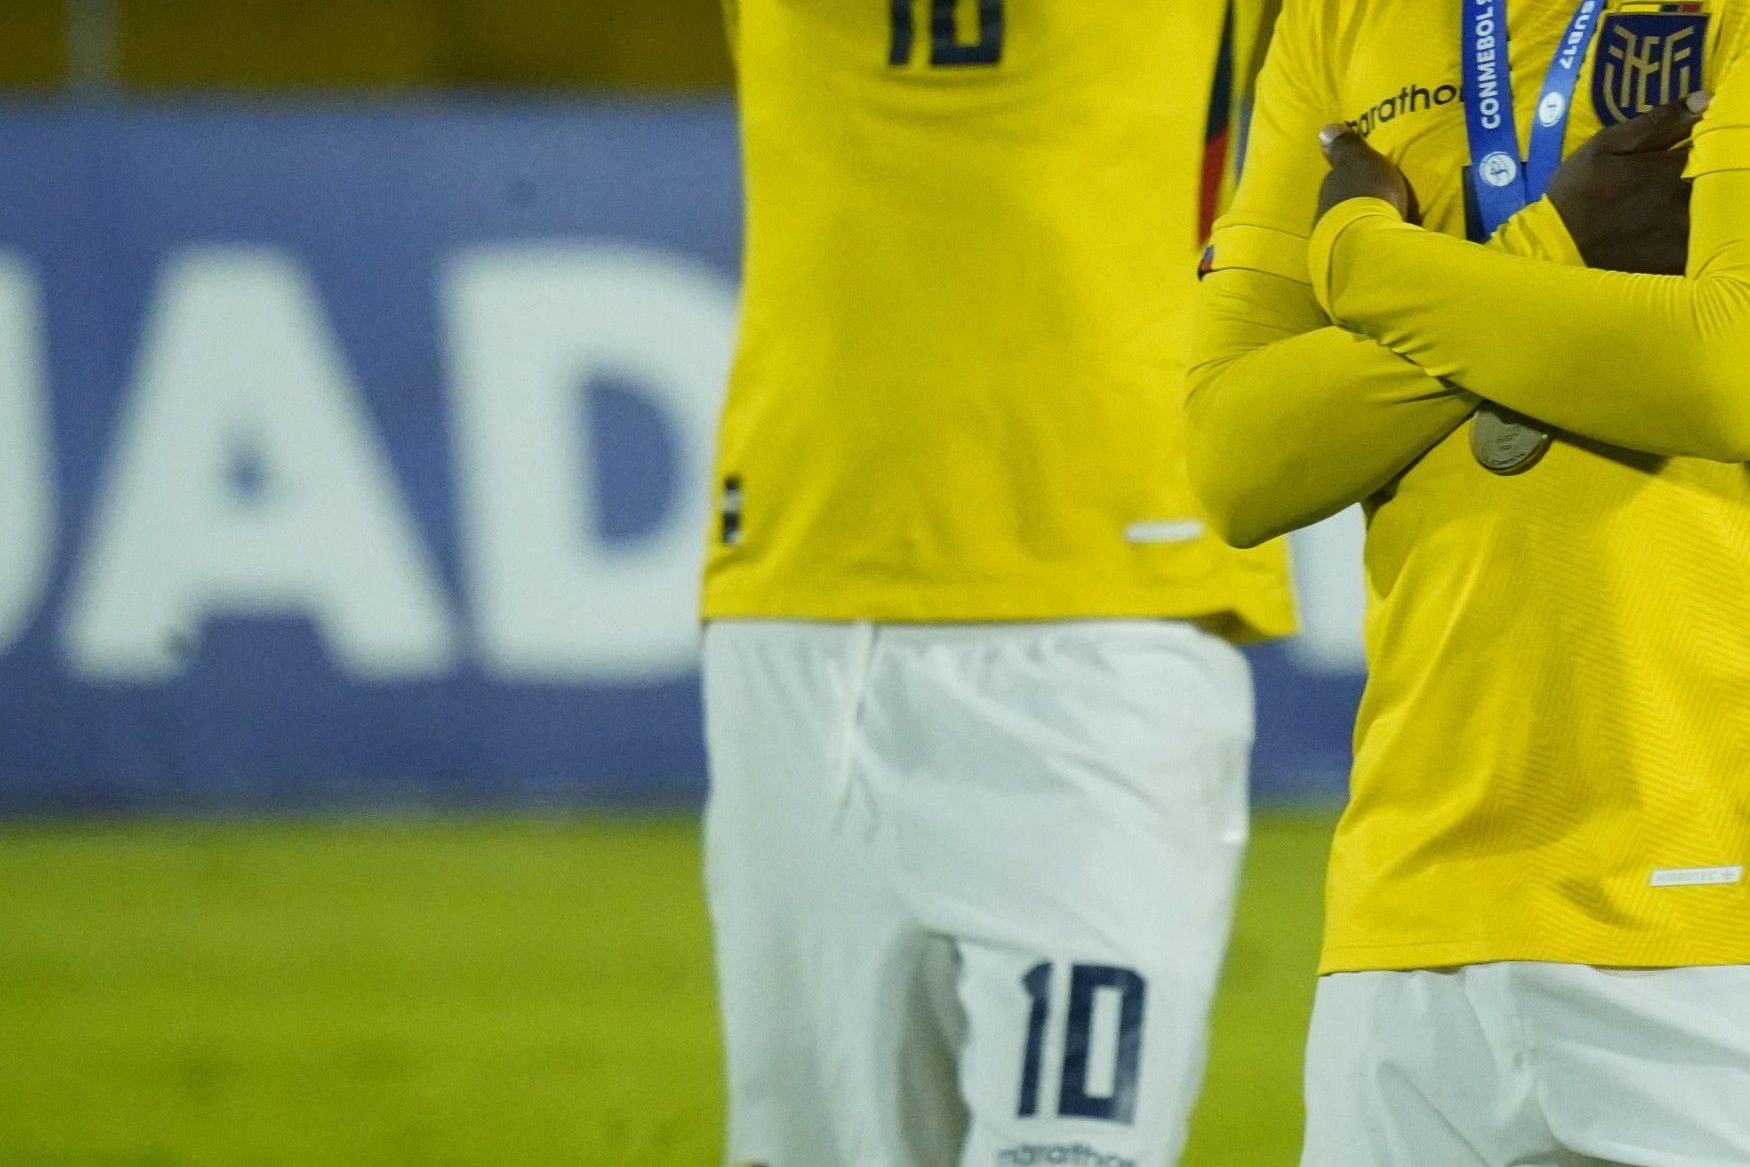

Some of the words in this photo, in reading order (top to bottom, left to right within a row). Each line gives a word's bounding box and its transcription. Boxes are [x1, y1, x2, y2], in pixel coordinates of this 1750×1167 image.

[1344, 84, 1464, 139] aratho
[1475, 6, 1502, 130] CONMEBOL
[1016, 960, 1149, 1126] 10
